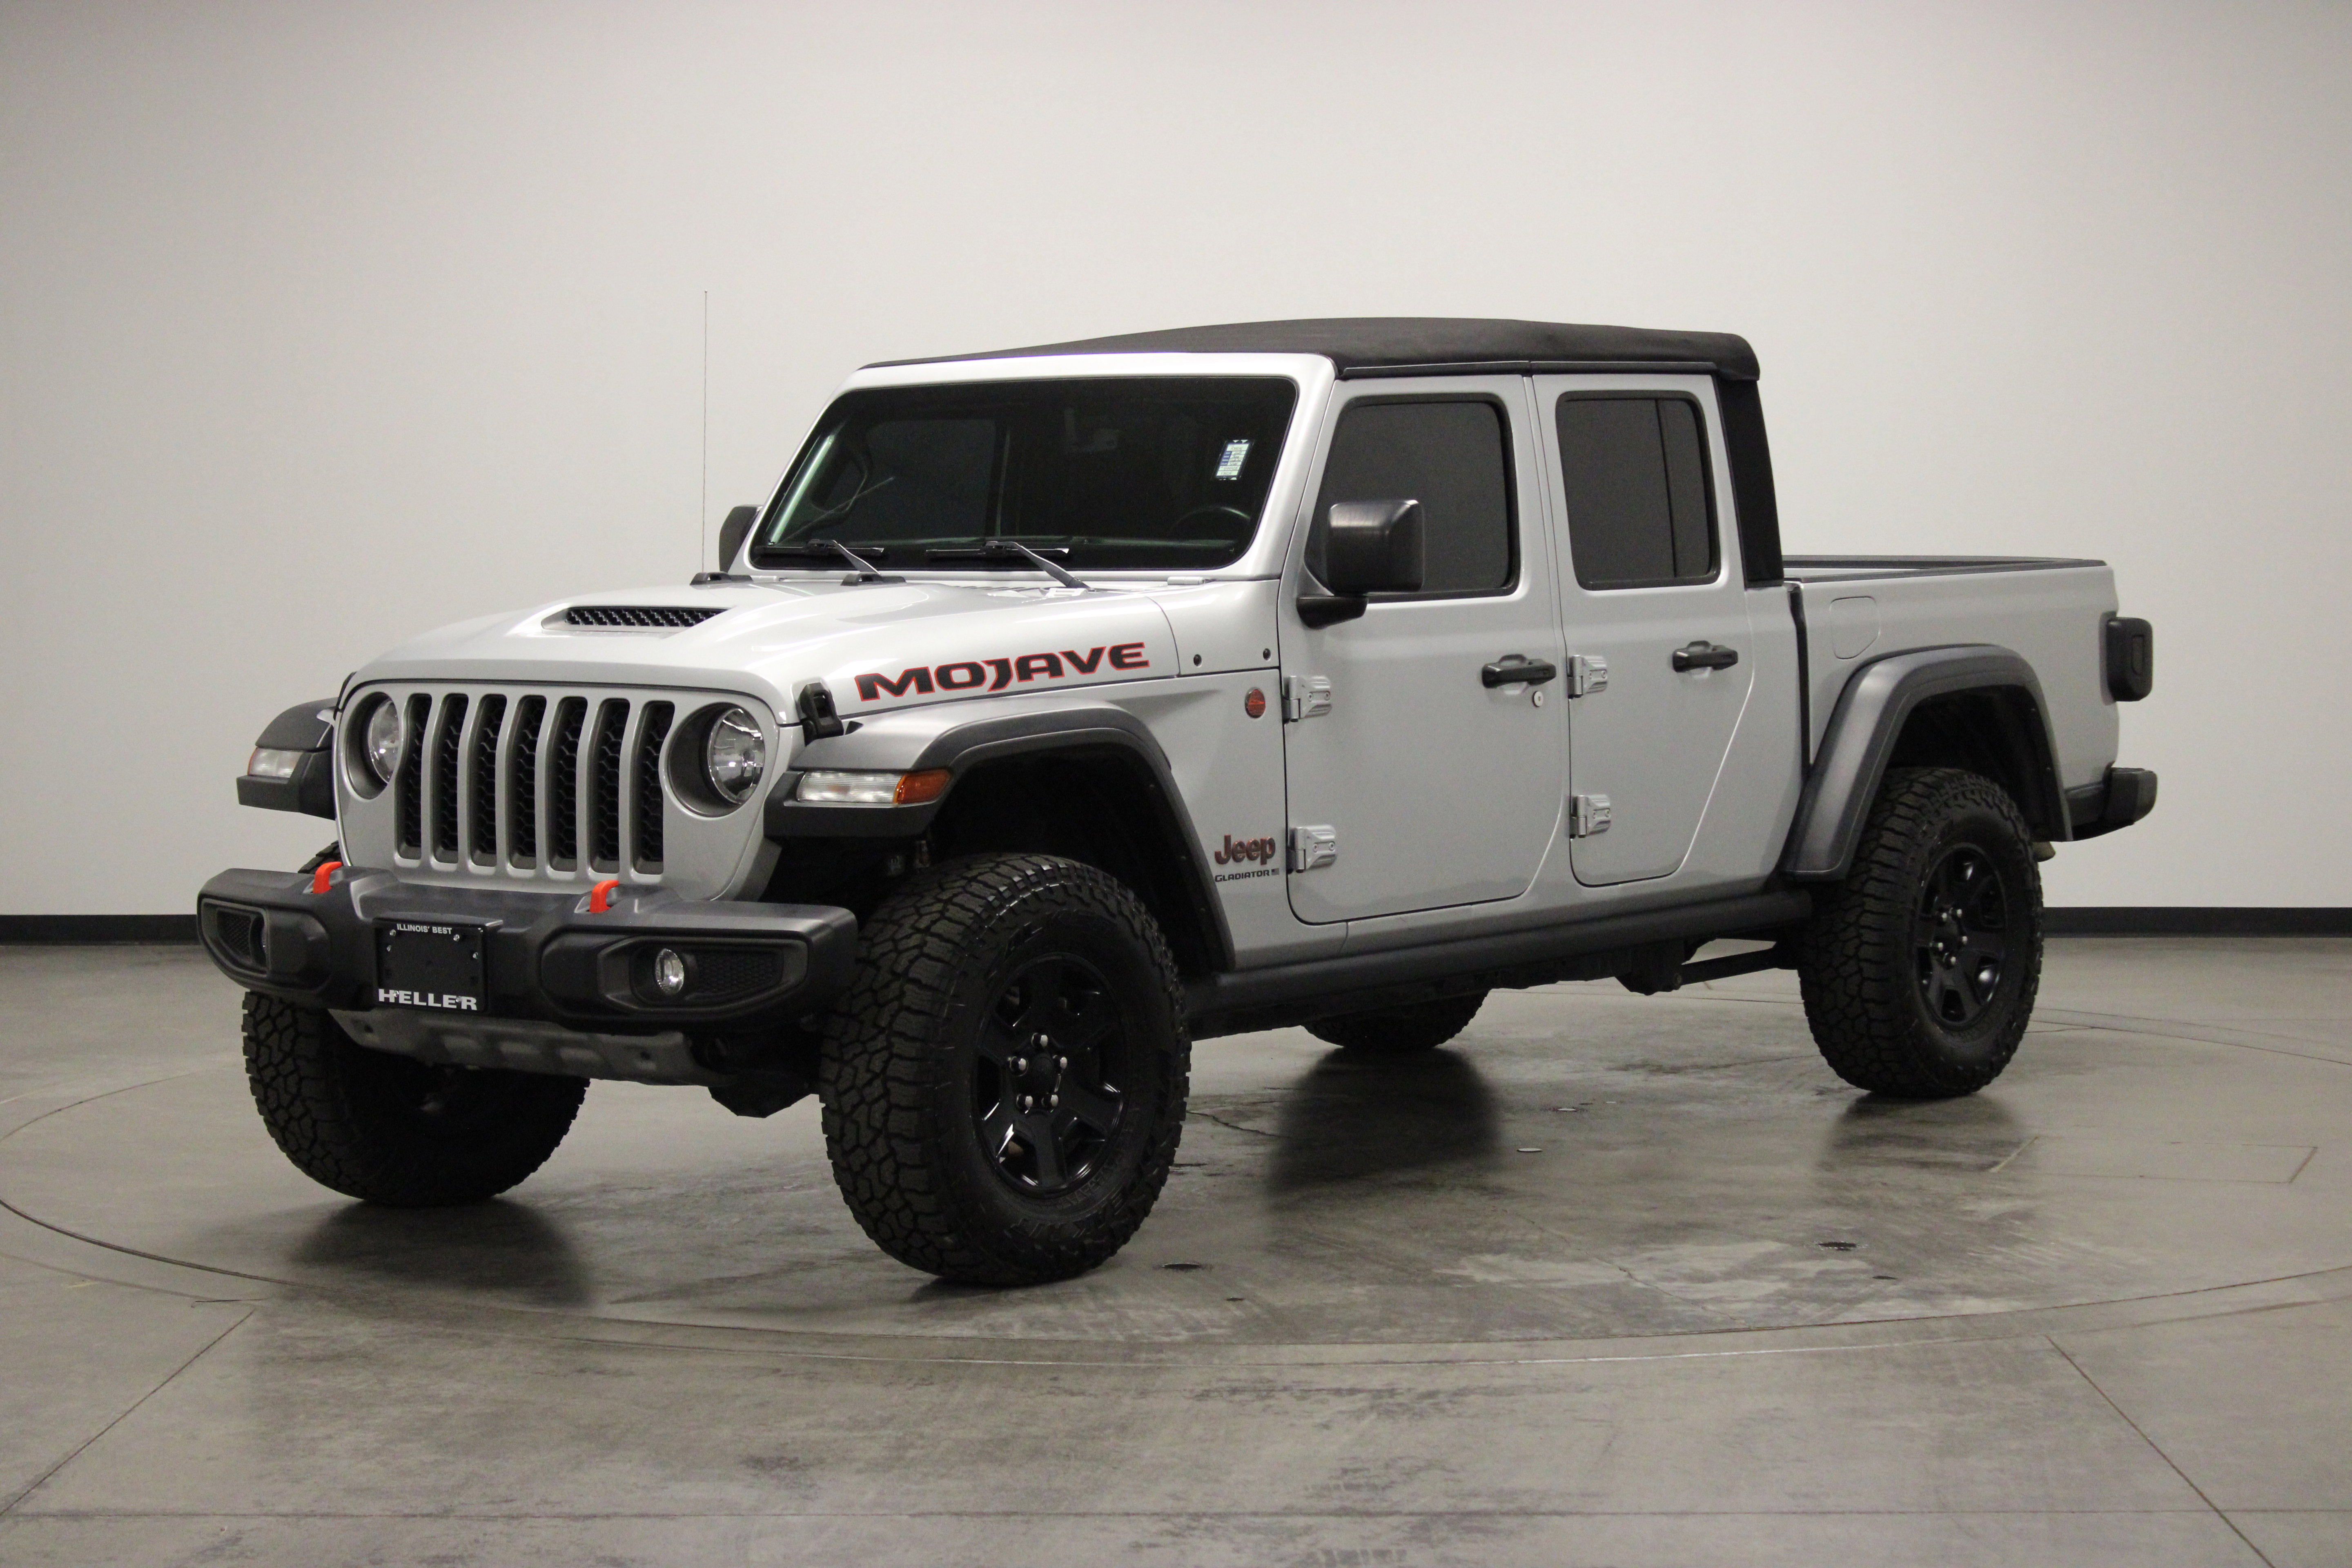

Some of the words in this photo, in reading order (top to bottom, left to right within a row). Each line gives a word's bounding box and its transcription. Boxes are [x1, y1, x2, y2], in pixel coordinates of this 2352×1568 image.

[854, 642, 1150, 702] MOJAVE
[1214, 835, 1276, 865] Jeep
[1214, 870, 1270, 882] GLADIATOR
[379, 989, 477, 1010] HELLER
